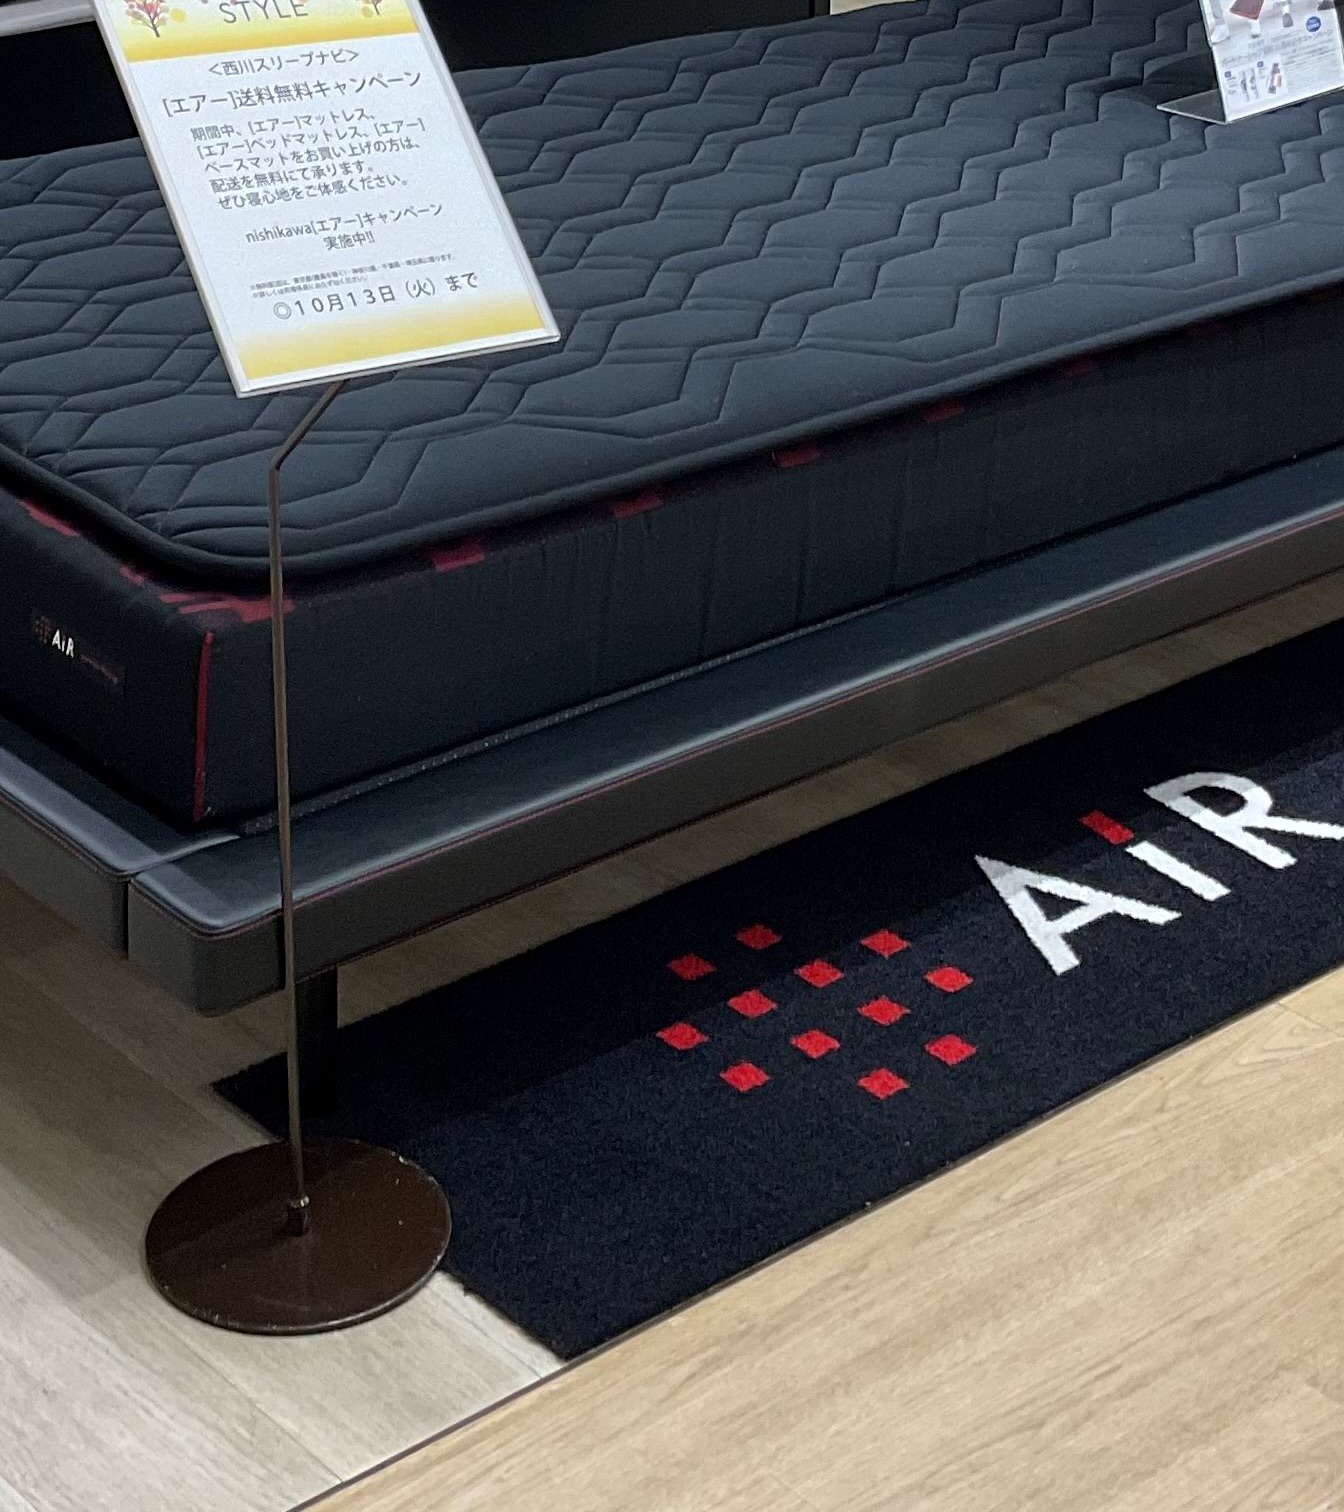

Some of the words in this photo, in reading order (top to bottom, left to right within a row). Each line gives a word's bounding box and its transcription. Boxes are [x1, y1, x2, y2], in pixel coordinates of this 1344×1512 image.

[162, 71, 422, 117] [エアー]送料無料キャンペーン
[190, 107, 376, 142] 期間中、[エアー]マットレス、
[197, 118, 425, 159] [エアー]ベッドマットレス、[エアー]
[205, 137, 422, 173] ベースマットをお買い上げの方は、
[209, 159, 373, 194] 配送を無料にて承ります。
[218, 173, 408, 210] ぜひ寝心地をご体感ください。
[246, 203, 443, 244] nishikawa[エアー]キャンペーン
[323, 231, 376, 250] 実施中!!
[52, 629, 74, 658] AiR
